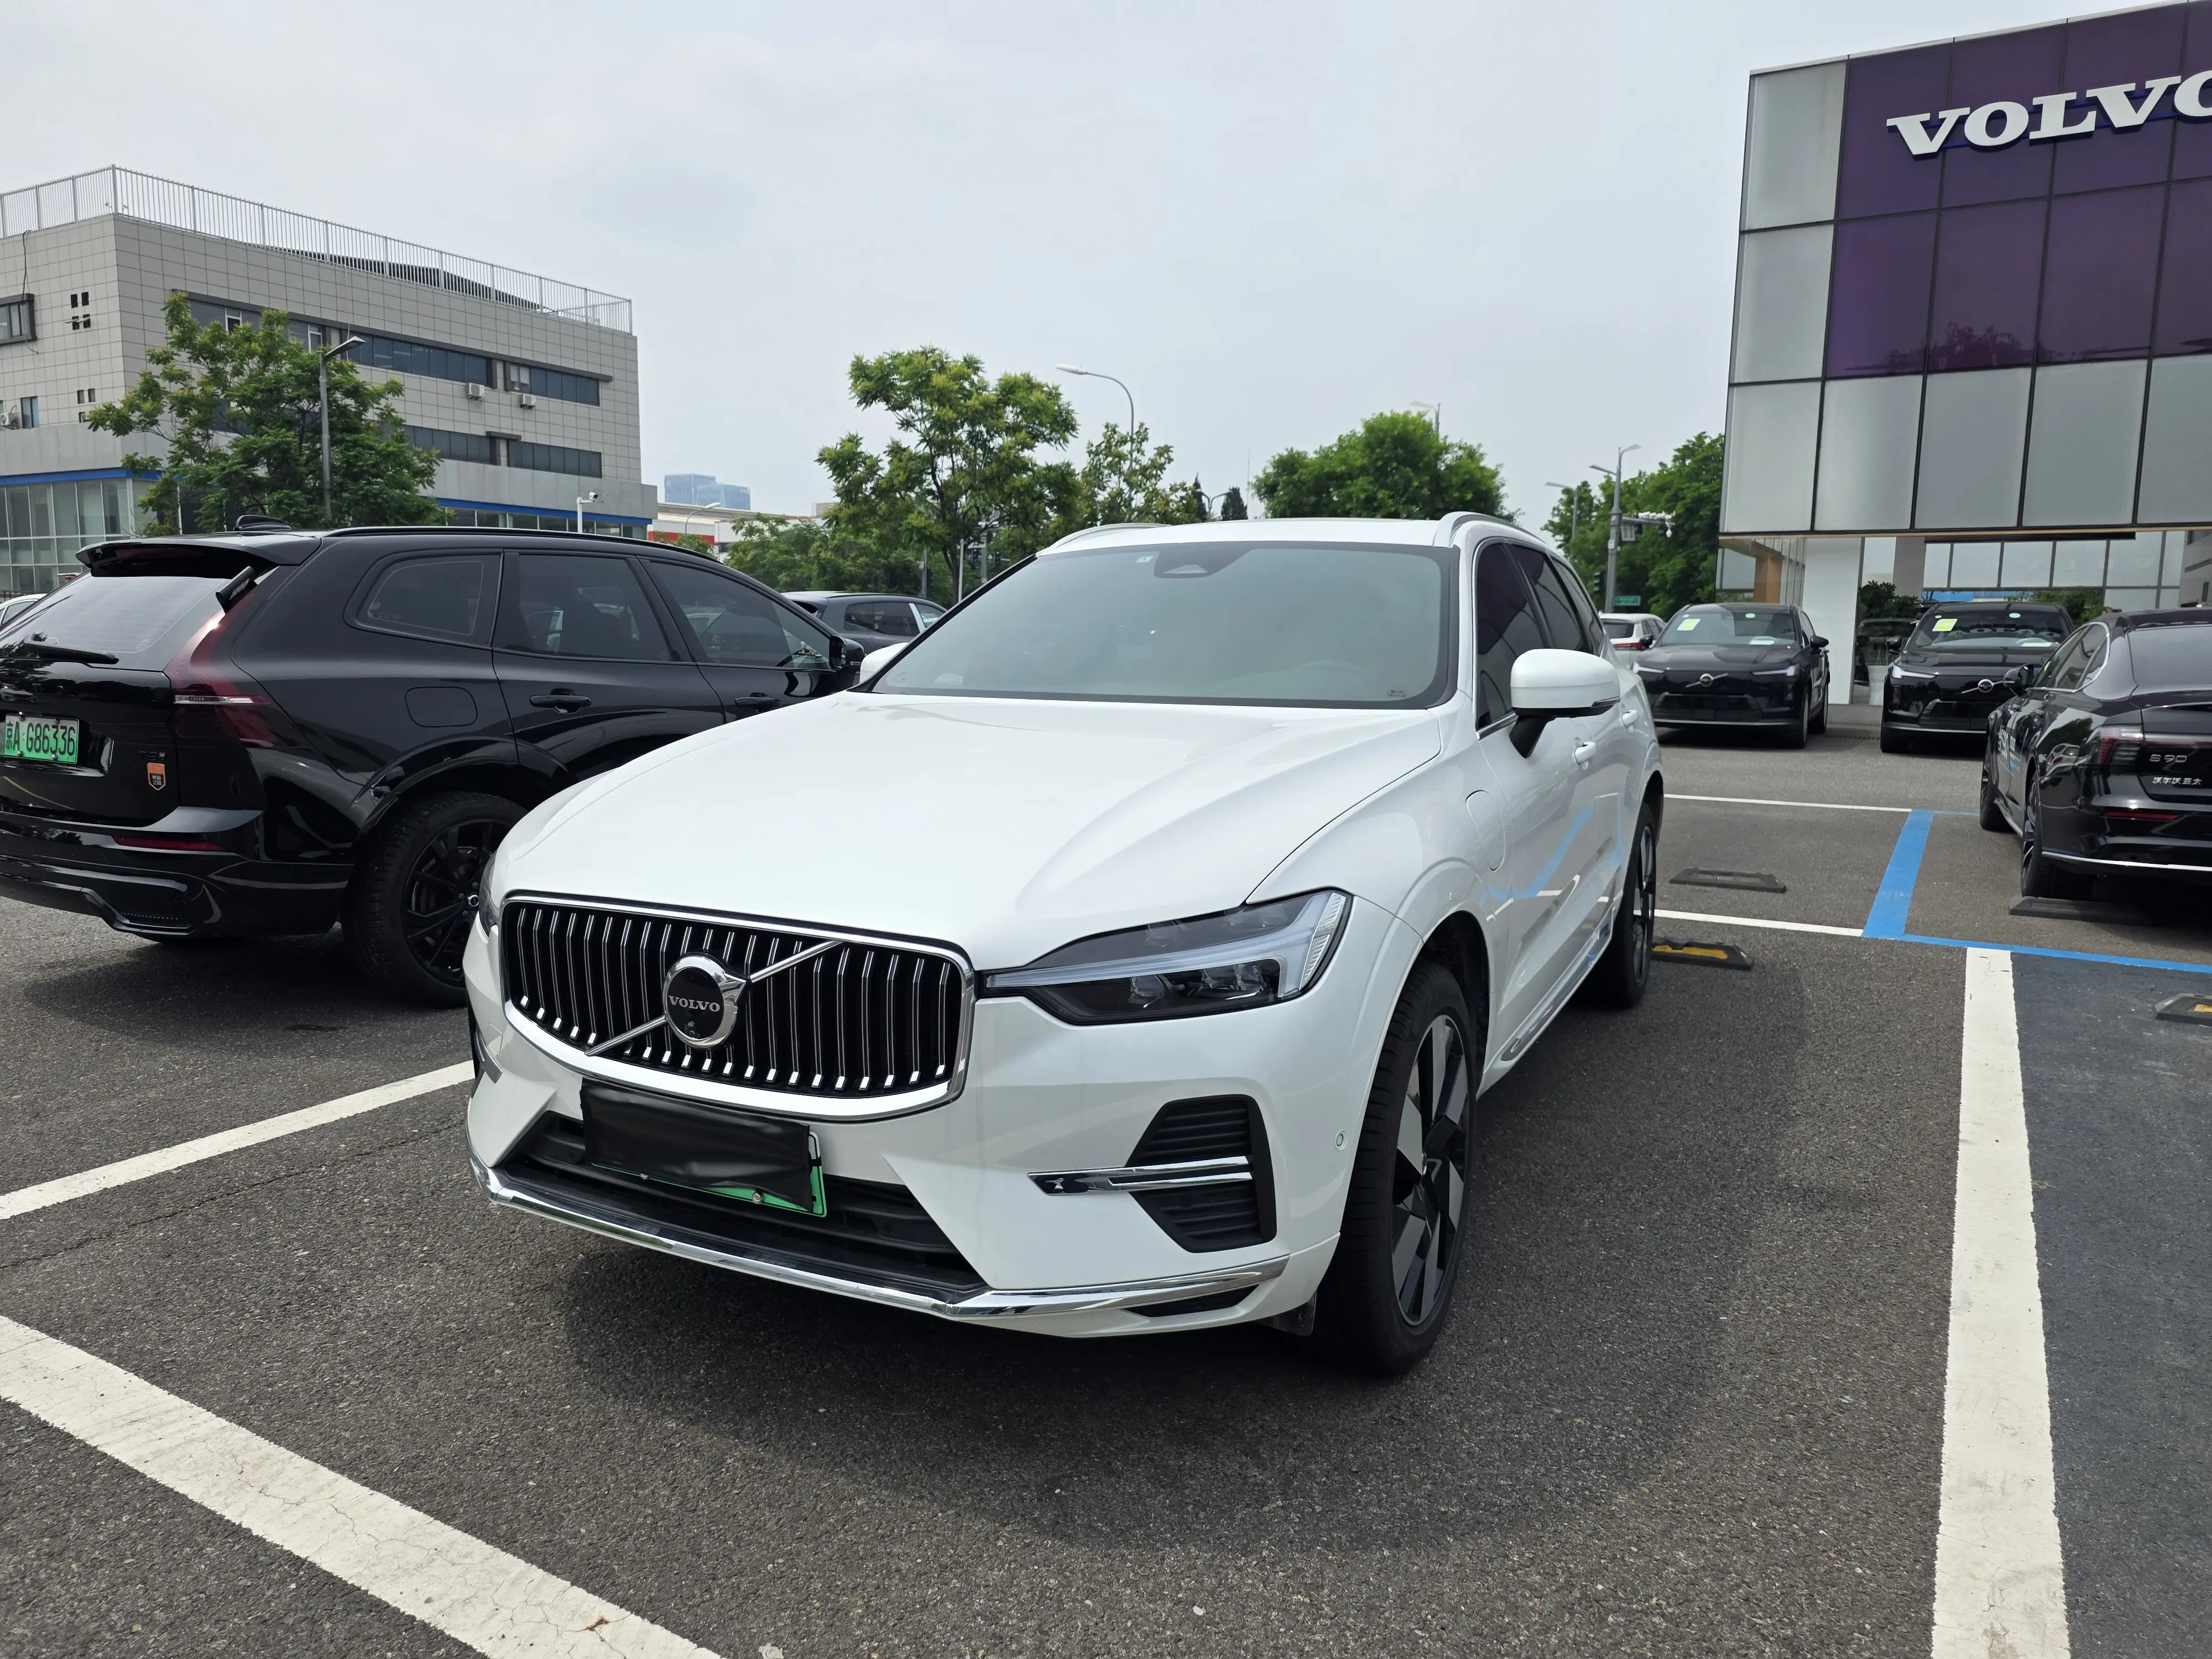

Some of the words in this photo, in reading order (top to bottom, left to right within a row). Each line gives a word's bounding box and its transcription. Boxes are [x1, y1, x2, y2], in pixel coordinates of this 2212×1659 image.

[2152, 777, 2202, 785] 沃尔沃亚太
[669, 995, 721, 1012] VOLVO
